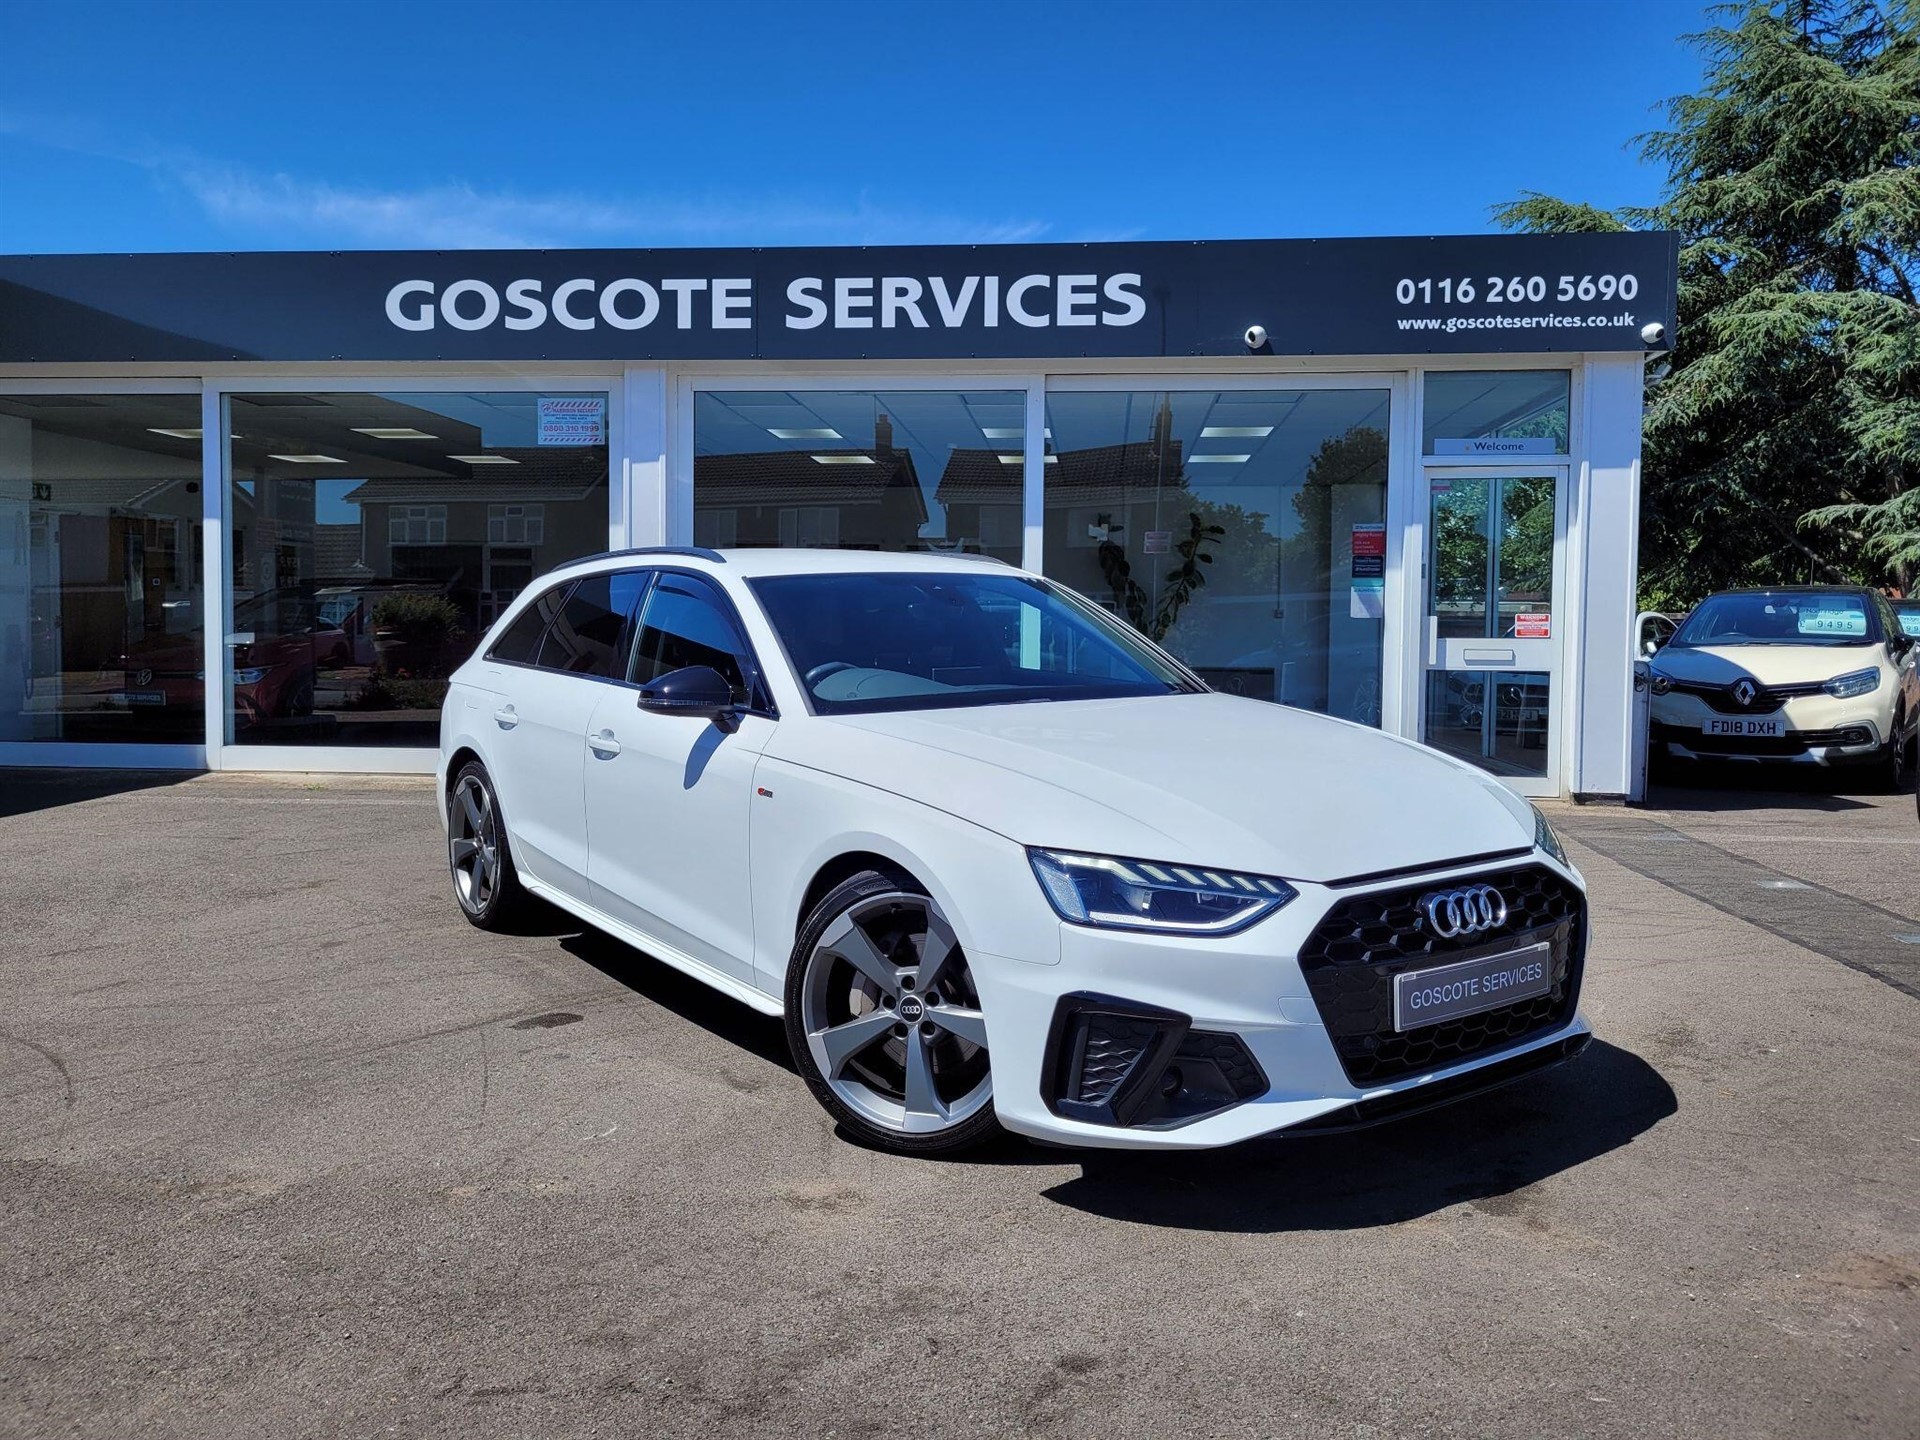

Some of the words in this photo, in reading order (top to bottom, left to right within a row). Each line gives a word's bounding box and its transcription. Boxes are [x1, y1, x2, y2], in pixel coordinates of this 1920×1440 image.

[1396, 277, 1476, 304] 0116
[1486, 275, 1546, 303] 260
[1557, 274, 1639, 301] 5690
[385, 277, 753, 332] GOSCOTE
[784, 273, 1147, 329] SERVICES
[1397, 312, 1635, 333] www.goscoteservices.co.uk
[1473, 441, 1525, 451] Welcome
[1816, 620, 1853, 629] 9495
[1711, 720, 1743, 733] FD18
[1747, 721, 1777, 735] DXH
[1410, 977, 1479, 1009] GOSCOTE
[1482, 962, 1542, 993] SERVICES
